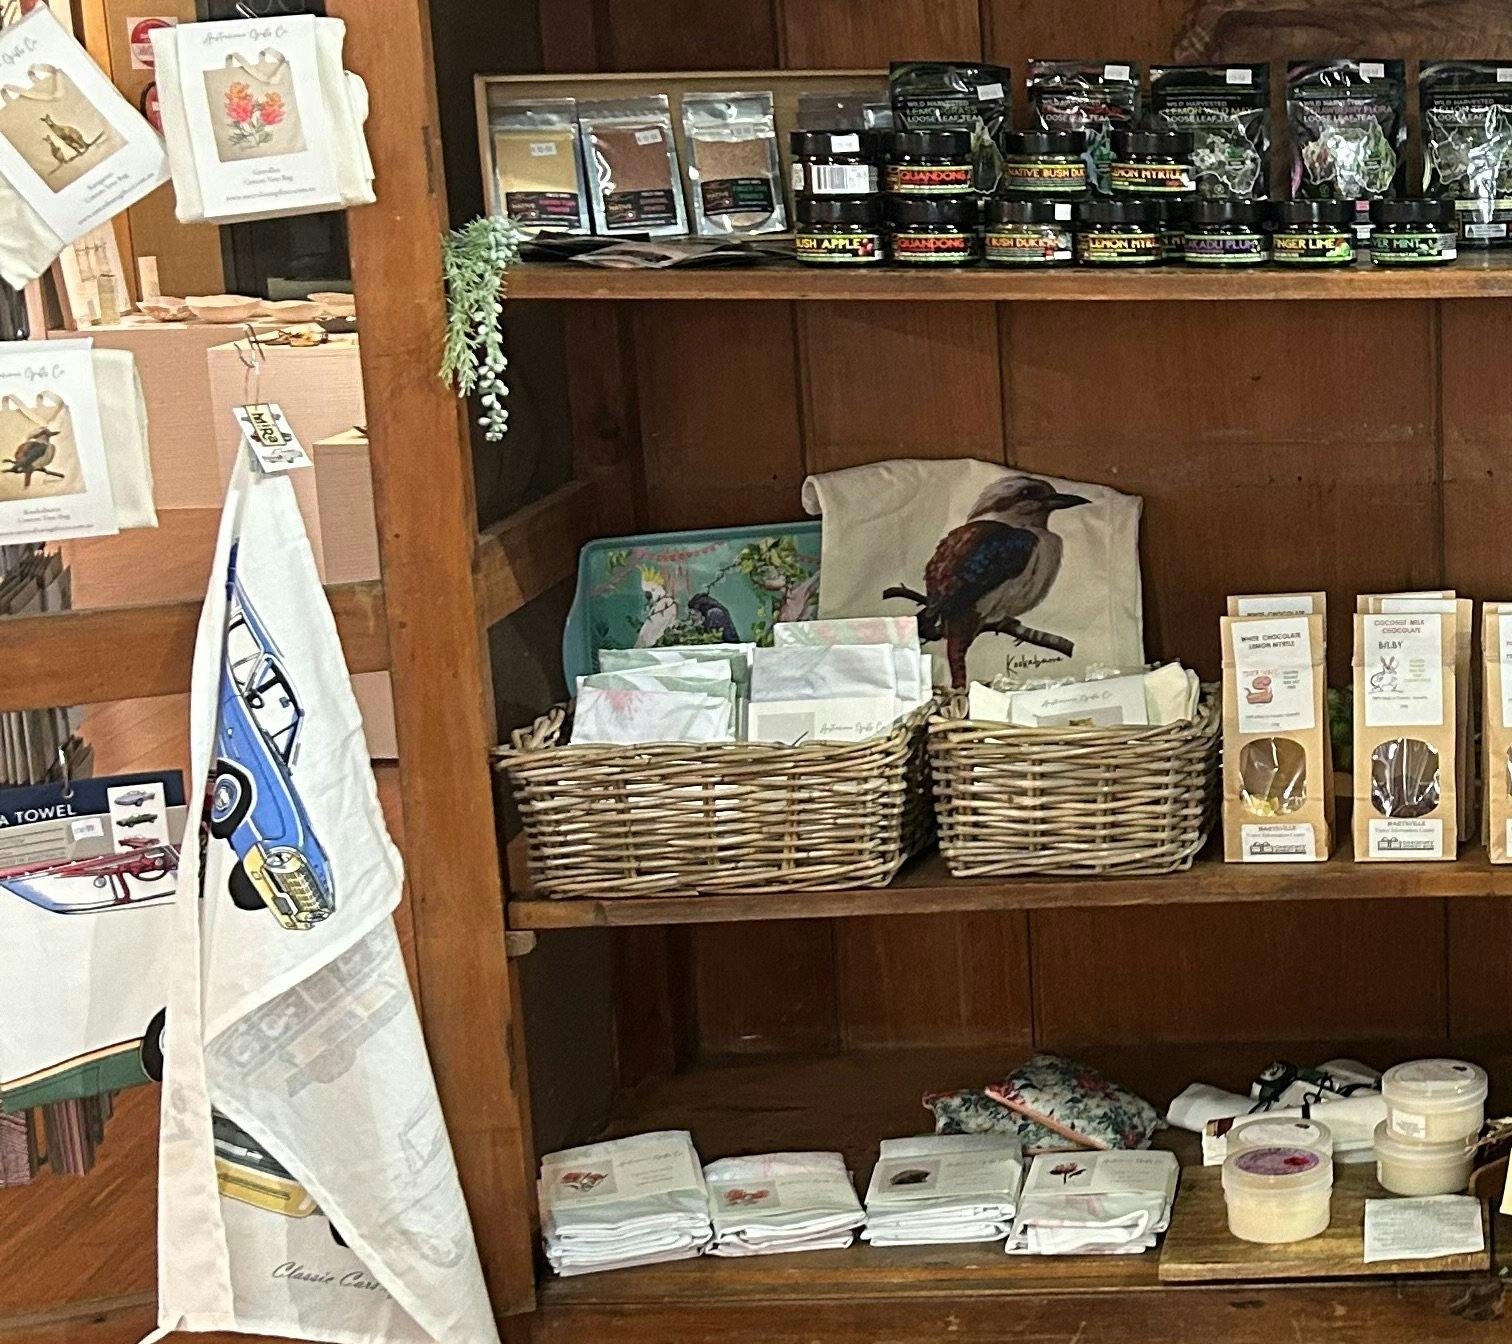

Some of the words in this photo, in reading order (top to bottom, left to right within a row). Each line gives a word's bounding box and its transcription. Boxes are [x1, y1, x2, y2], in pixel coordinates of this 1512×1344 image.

[901, 171, 967, 182] QUANDONG
[1042, 167, 1069, 178] BUSH
[821, 238, 863, 250] APPLE
[900, 238, 966, 249] QUANDONG
[1090, 238, 1128, 249] LEMON
[1308, 238, 1337, 249] LIME
[1392, 238, 1421, 249] MINT
[14, 803, 78, 824] TOWEL
[272, 1261, 335, 1285] Classic
